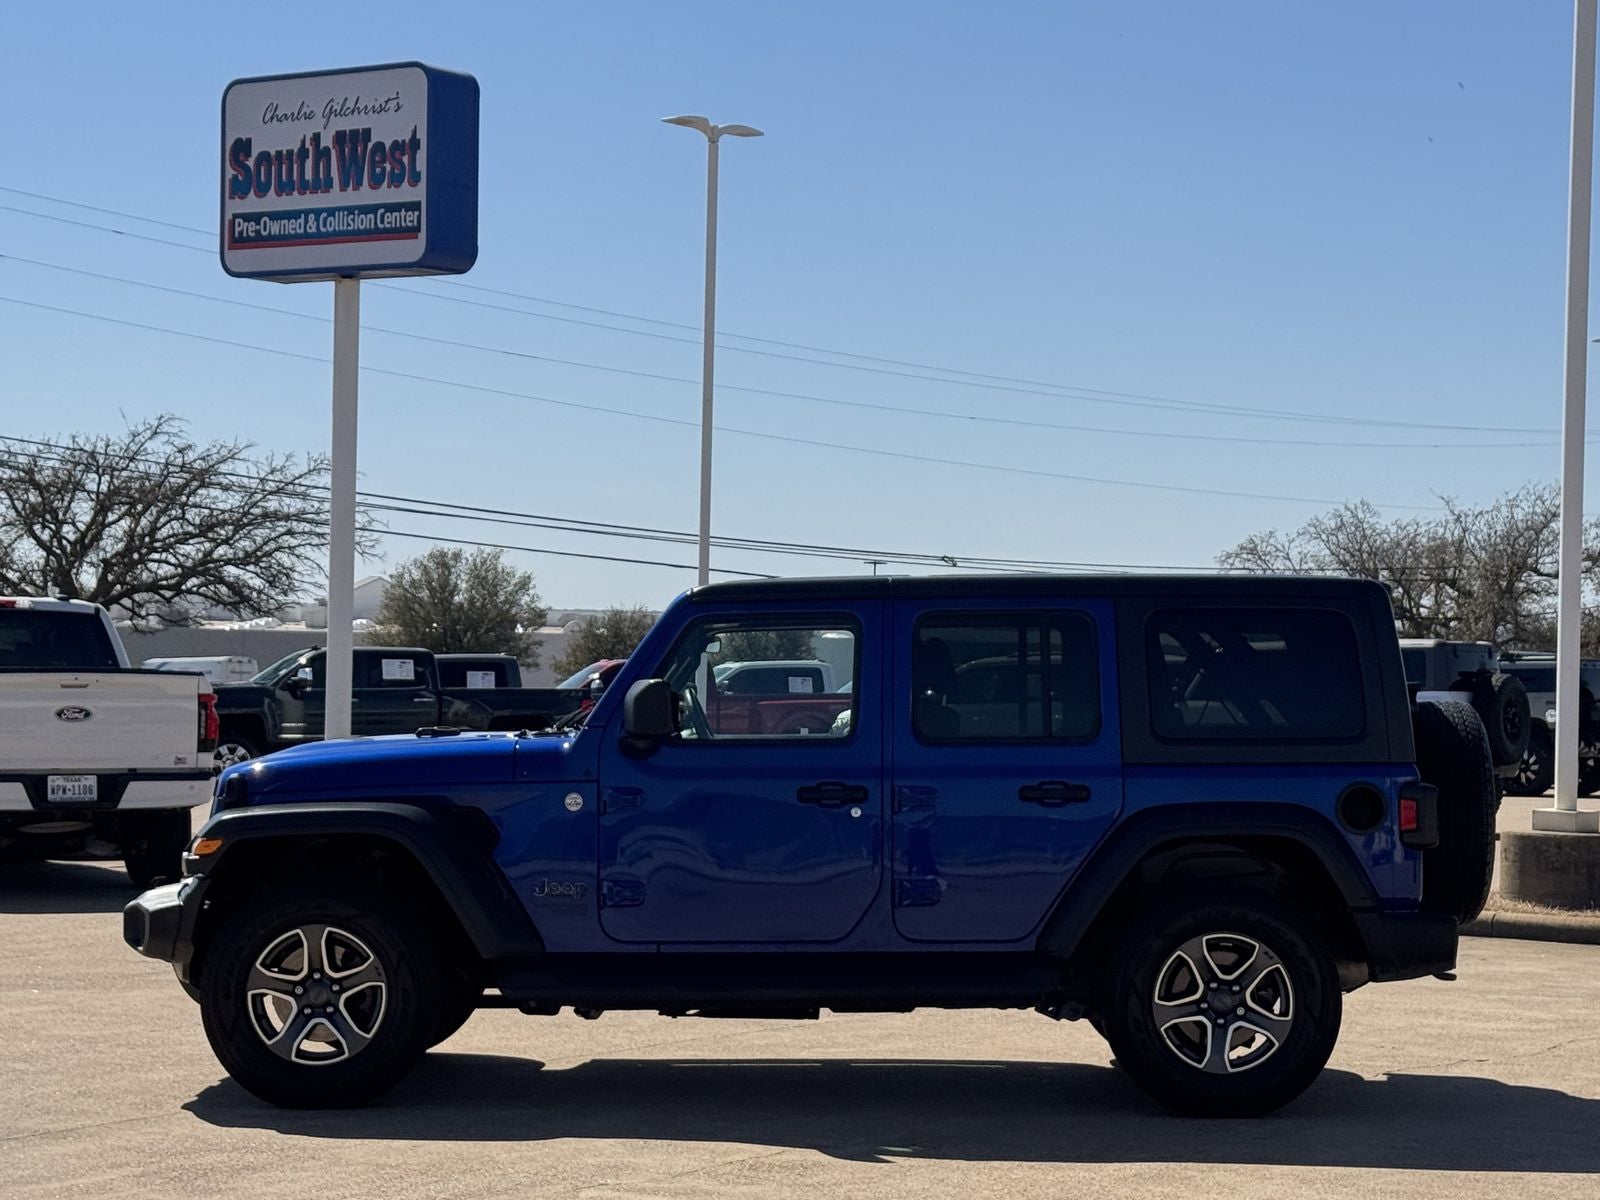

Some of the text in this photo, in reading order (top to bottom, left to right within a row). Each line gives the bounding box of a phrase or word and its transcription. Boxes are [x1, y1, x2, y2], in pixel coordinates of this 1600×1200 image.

[262, 91, 403, 130] Charlie Gilchrist's
[228, 124, 422, 201] SouthWest
[233, 207, 420, 238] Pre-Owned & Collision Center
[60, 707, 86, 719] Ford
[533, 877, 589, 899] Jeep
